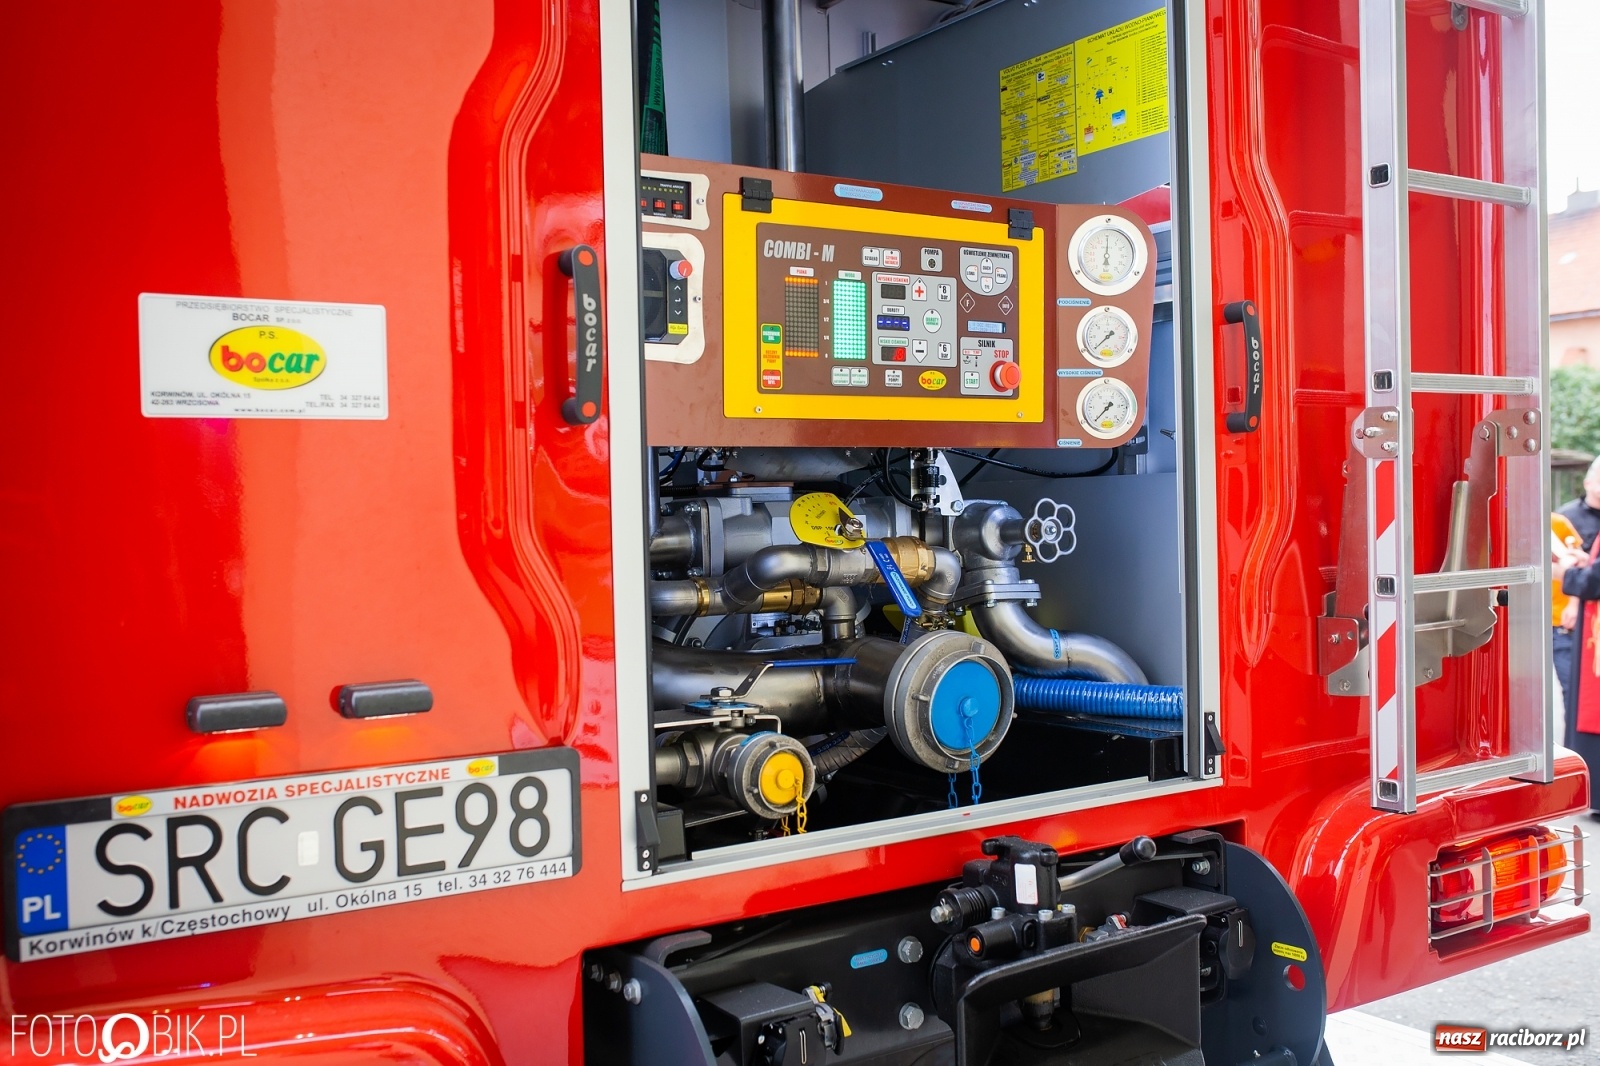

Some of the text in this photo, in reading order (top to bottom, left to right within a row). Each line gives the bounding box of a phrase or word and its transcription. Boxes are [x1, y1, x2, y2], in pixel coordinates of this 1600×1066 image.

[764, 239, 812, 260] COMBI
[822, 244, 835, 262] M
[176, 300, 353, 316] PRZEDSIĘBIORSTWO SPECJALISTYCZNE
[232, 313, 270, 322] BOCAR
[259, 331, 279, 339] P.S.
[582, 294, 597, 372] bocar
[978, 340, 995, 348] SILNIK
[221, 345, 320, 374] bocar
[994, 350, 1009, 358] STOP
[1251, 337, 1260, 394] bocar
[921, 376, 945, 384] bocar
[174, 767, 450, 810] NADWOZIA SPECJALISTYCZNE
[96, 776, 550, 917] SRC GE98
[22, 896, 61, 923] PL
[29, 862, 566, 956] Korwinów k/Częstochowy ul. Okólna 15 tel. 34 32 76 444
